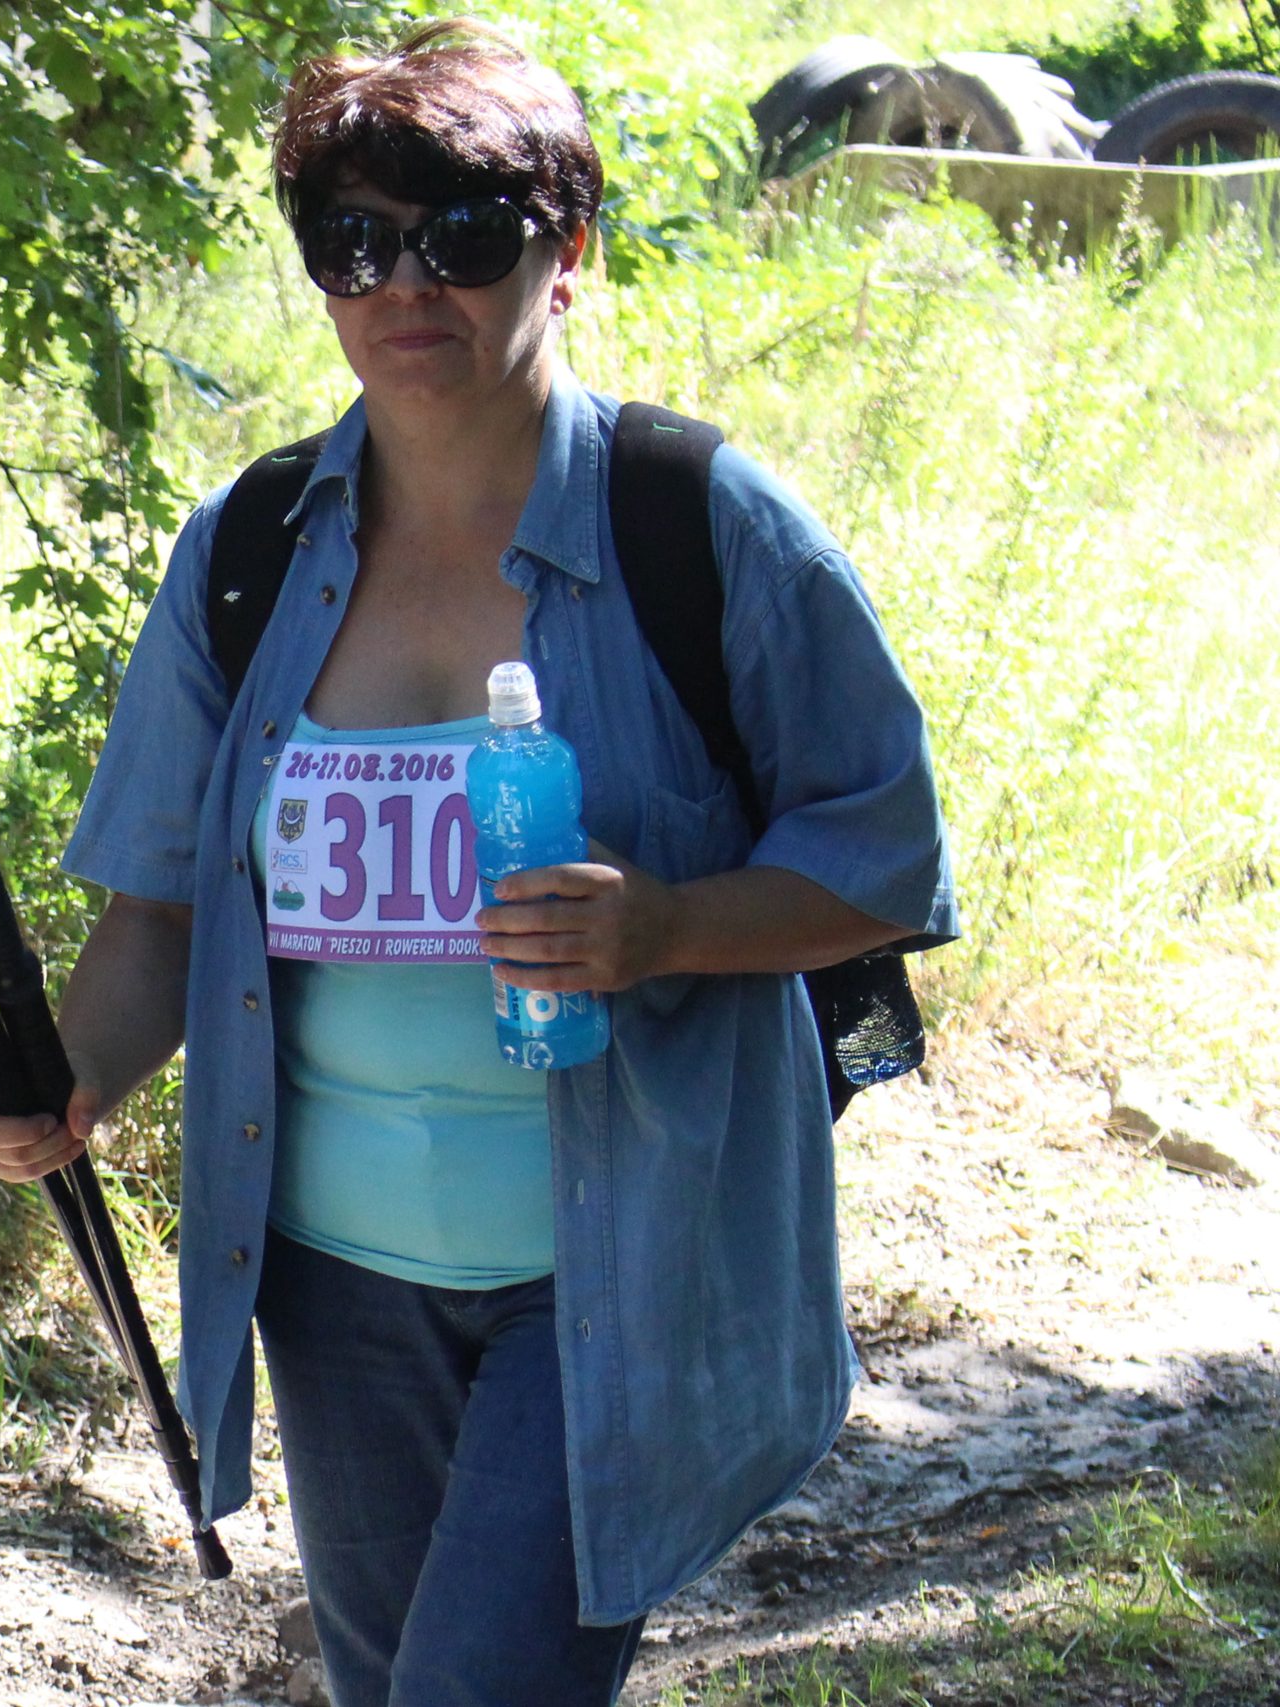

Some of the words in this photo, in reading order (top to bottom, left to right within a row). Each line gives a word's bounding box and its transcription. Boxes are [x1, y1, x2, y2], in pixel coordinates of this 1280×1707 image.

[320, 791, 479, 923] 310
[280, 933, 323, 953] MARATON
[375, 938, 381, 955] I
[385, 938, 444, 956] ROWEREM
[448, 938, 485, 956] DOOK
